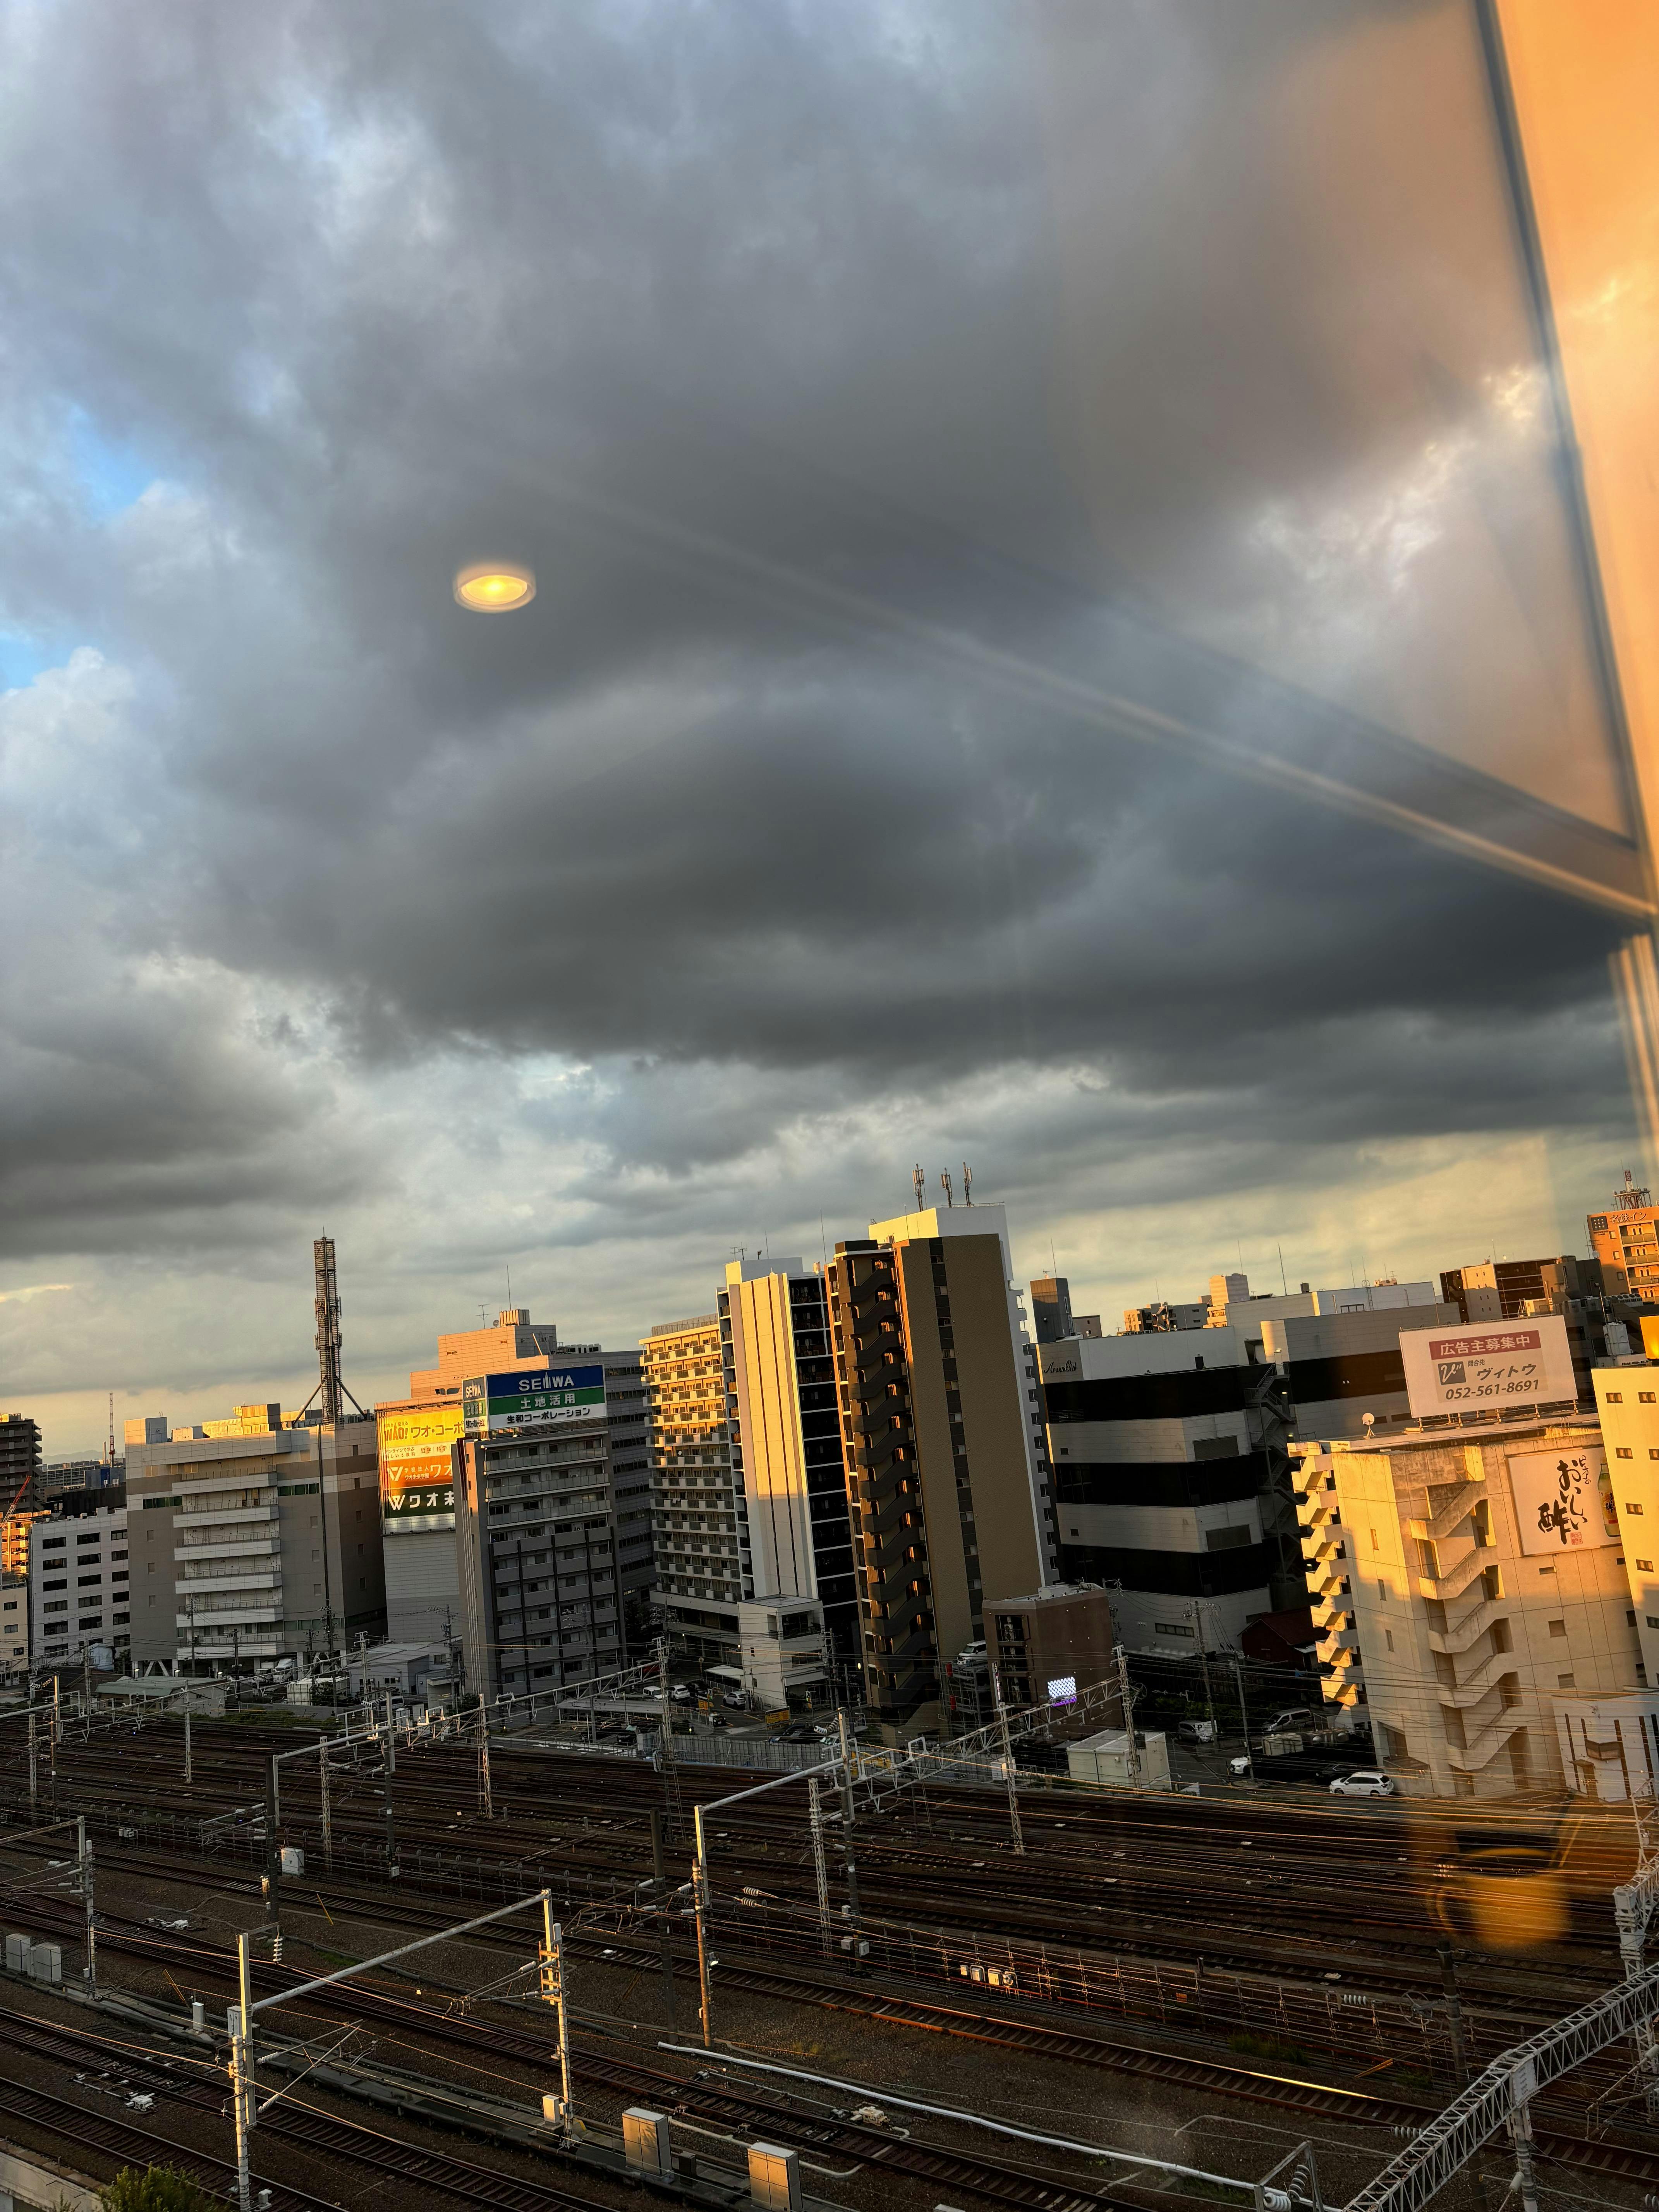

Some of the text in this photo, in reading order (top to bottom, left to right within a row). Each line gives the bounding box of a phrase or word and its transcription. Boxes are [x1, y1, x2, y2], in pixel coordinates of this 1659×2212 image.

[1610, 1212, 1647, 1223] 名鉄イン
[1440, 1334, 1530, 1356] 広告主募集中
[1468, 1359, 1485, 1367] 問合先
[1477, 1364, 1537, 1381] ヴィトウ
[1446, 1379, 1539, 1400] 052-561-8691
[520, 1393, 576, 1409] 土地活用
[507, 1407, 590, 1424] 生和コーポレーション
